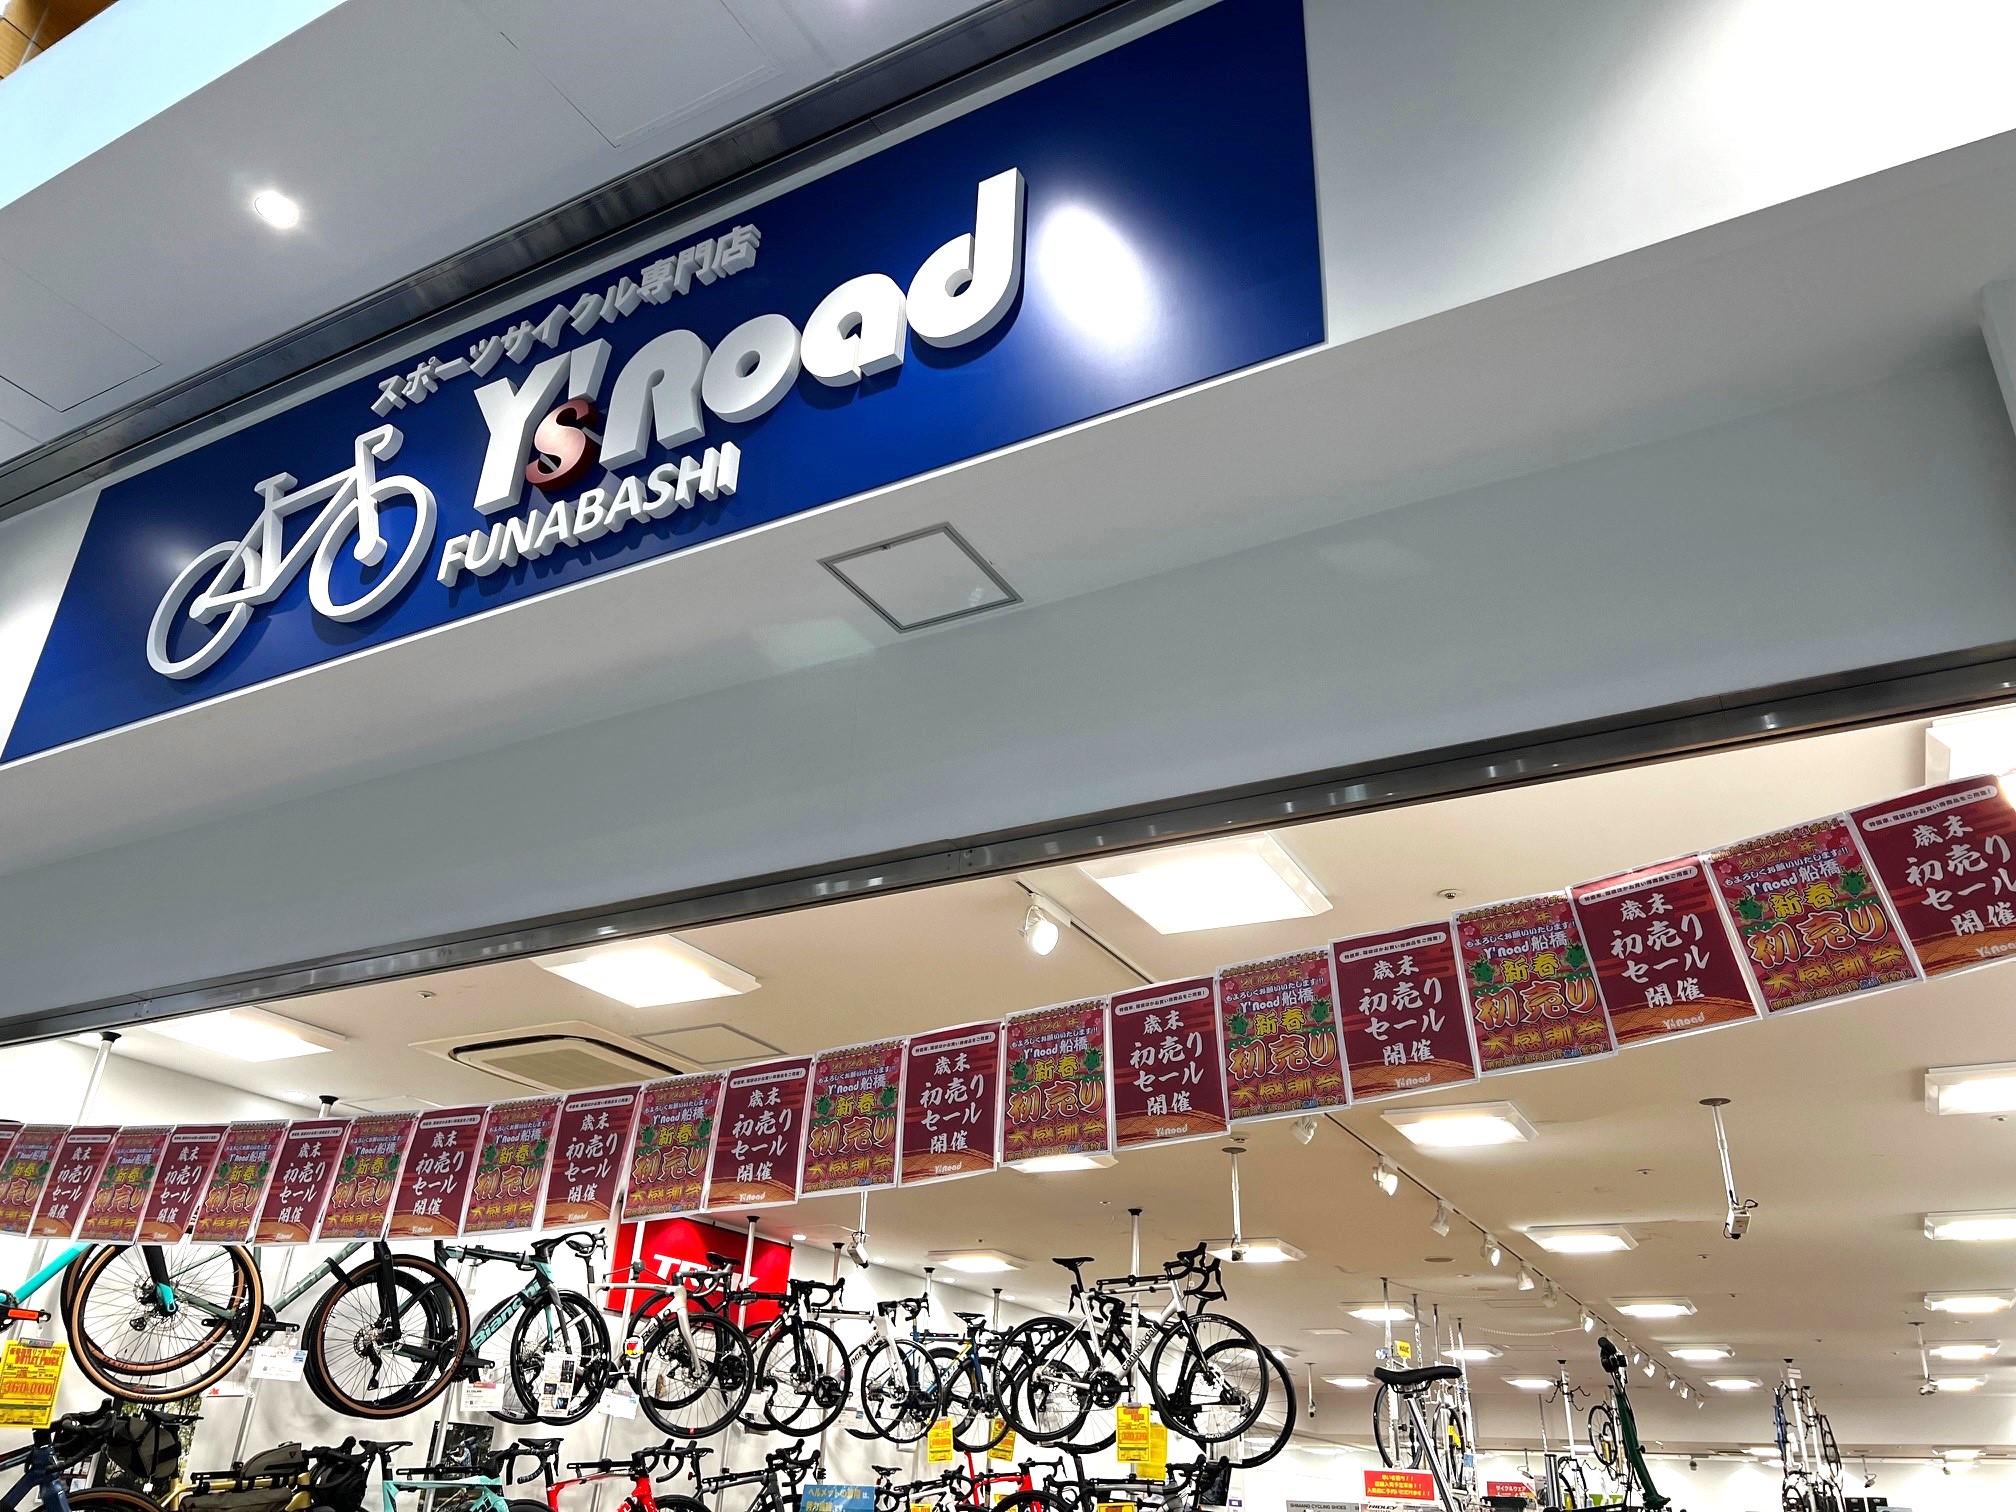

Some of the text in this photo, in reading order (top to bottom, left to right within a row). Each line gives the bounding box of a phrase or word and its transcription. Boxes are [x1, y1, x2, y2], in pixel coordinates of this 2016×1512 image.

[371, 222, 762, 416] スポーツサイクル専門店
[436, 441, 742, 587] FUNABASHI
[1912, 816, 1973, 848] 歳末
[1905, 835, 2010, 886] 初売り
[1773, 883, 1832, 916] 新春
[1922, 870, 2016, 911] セール
[1620, 893, 1672, 921] 歳末
[1951, 903, 2016, 936] 開催
[1610, 913, 1702, 958] 初売り
[1747, 904, 1888, 967] 初売り
[1372, 955, 1418, 980] 歳末
[1504, 953, 1556, 981] 新春
[1621, 945, 1709, 982] セール
[1359, 977, 1441, 1015] 初売り
[1474, 977, 1599, 1030] 初売り
[1644, 977, 1704, 1007] 開催
[1143, 1010, 1183, 1034] 歳末
[1256, 1008, 1303, 1034] 新春
[1364, 1008, 1444, 1040] セール
[934, 1052, 969, 1075] 歳末
[1130, 1031, 1201, 1068] 初売り
[1229, 1032, 1336, 1080] 初売り
[1382, 1039, 1434, 1065] 開催
[1035, 1056, 1076, 1080] 新春
[1133, 1061, 1203, 1091] セール
[747, 1087, 780, 1107] 歳末
[836, 1093, 873, 1116] 新春
[920, 1074, 983, 1107] 初売り
[1008, 1080, 1104, 1124] 初売り
[1147, 1090, 1195, 1115] 開催
[580, 1112, 608, 1130] 歳末
[732, 1108, 791, 1137] 初売り
[921, 1102, 981, 1130] セール
[431, 1130, 456, 1147] 歳末
[566, 1133, 617, 1160] 初売り
[659, 1124, 692, 1145] 新春
[731, 1135, 787, 1159] セール
[809, 1116, 895, 1157] 初売り
[930, 1130, 970, 1153] 開催
[297, 1141, 321, 1157] 歳末
[415, 1151, 463, 1174] 初売り
[499, 1145, 529, 1164] 新春
[230, 1165, 254, 1181] 新春
[283, 1161, 324, 1183] 初売り
[356, 1157, 384, 1173] 新春
[564, 1159, 611, 1181] セール
[633, 1146, 708, 1184] 初売り
[735, 1161, 772, 1184] 開催
[279, 1185, 316, 1203] セール
[332, 1176, 393, 1209] 初売り
[412, 1174, 456, 1195] セール
[474, 1165, 542, 1200] 初売り
[567, 1183, 597, 1204] 開催
[205, 1182, 262, 1213] 初売り
[411, 1197, 442, 1215] 開催
[277, 1206, 303, 1224] 開催
[1122, 1326, 1157, 1370] cannondal
